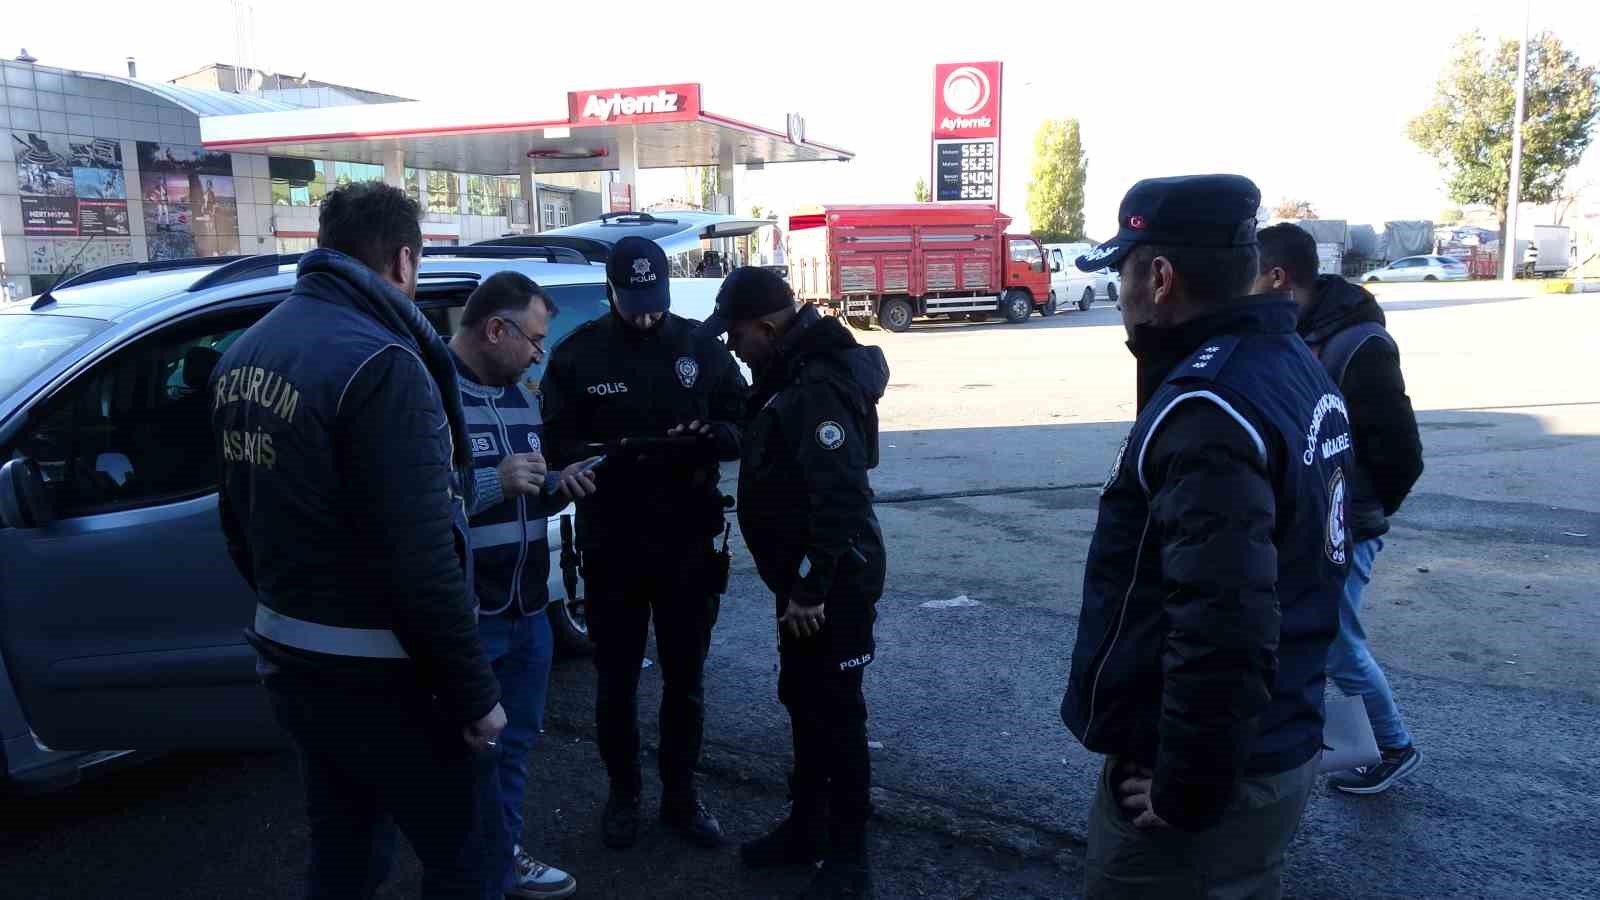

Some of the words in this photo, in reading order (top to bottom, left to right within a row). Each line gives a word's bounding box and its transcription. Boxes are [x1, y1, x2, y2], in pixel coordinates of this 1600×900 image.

[582, 89, 678, 121] Aytemiz
[940, 117, 992, 131] Aytemiz
[215, 366, 299, 423] RZURUM
